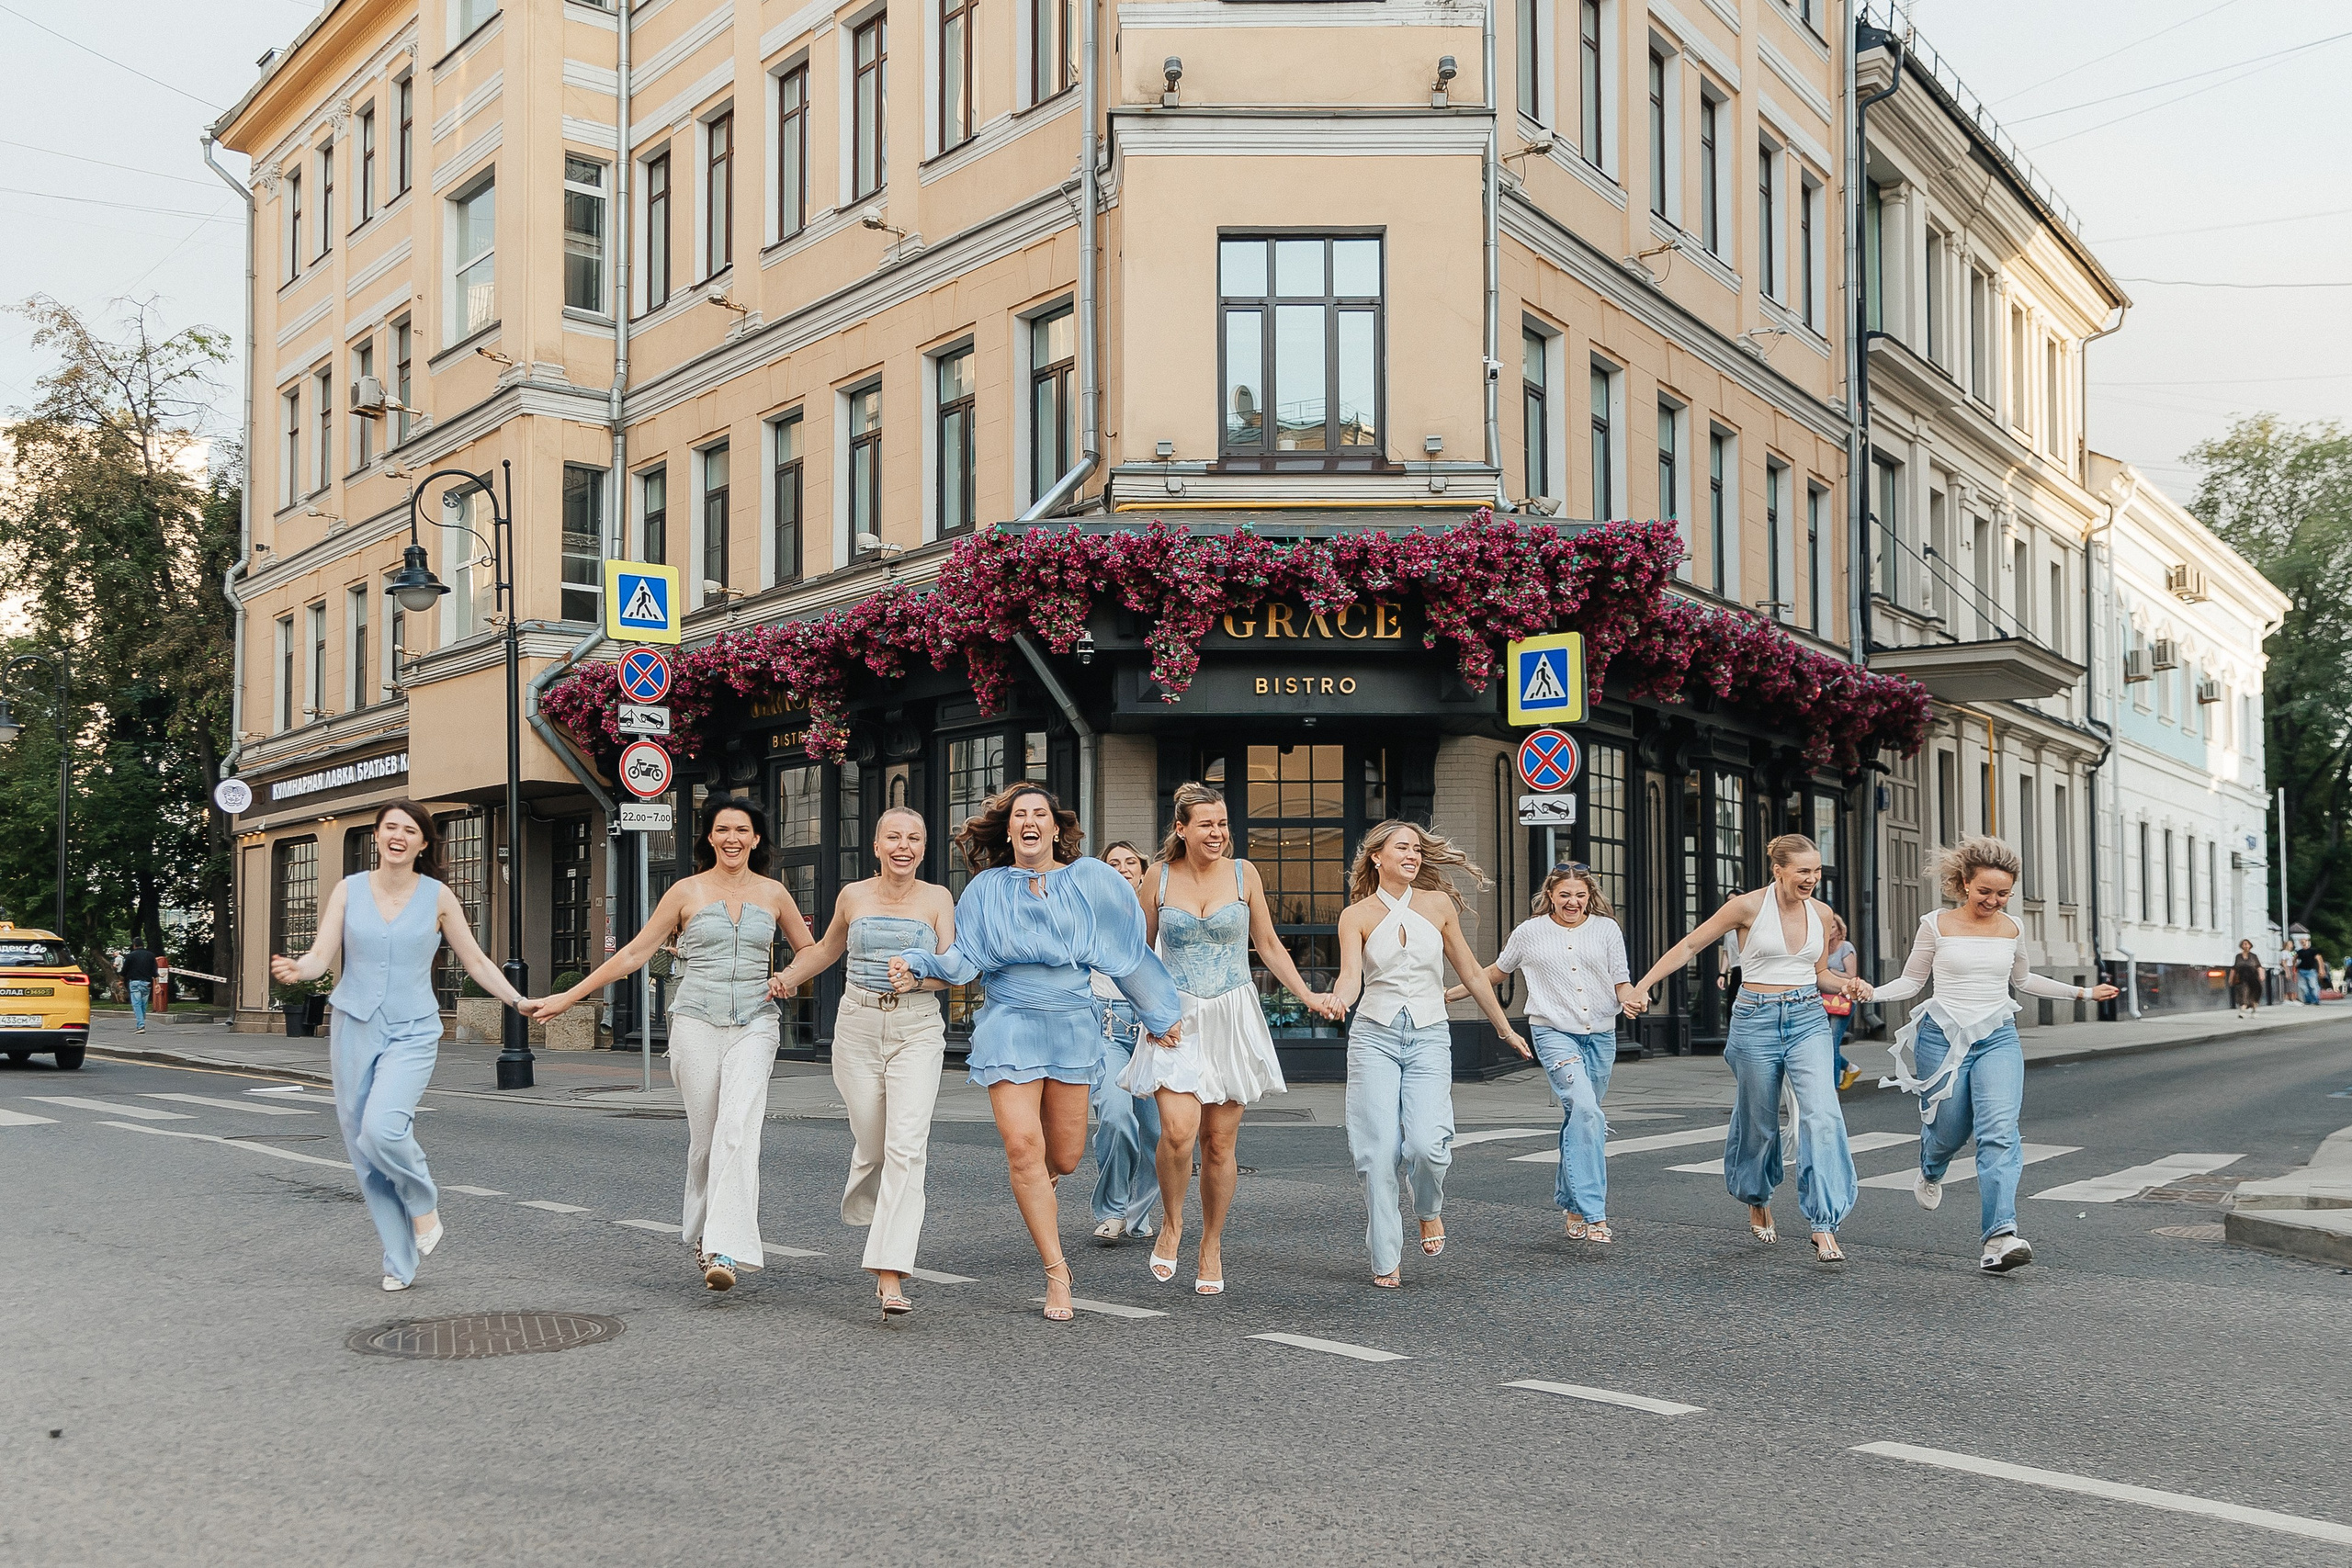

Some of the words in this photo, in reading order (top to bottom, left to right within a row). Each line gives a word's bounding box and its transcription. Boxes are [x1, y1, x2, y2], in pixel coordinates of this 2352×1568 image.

[1224, 603, 1402, 639] GRACE
[1255, 677, 1357, 695] BISTRO
[272, 773, 325, 801] КУЛИНАРНАЯ
[325, 766, 355, 789] ЛАВКА
[356, 755, 398, 782] БРАТЬЕВ
[622, 812, 671, 822] 22.00-7.00
[28, 943, 47, 953] Go
